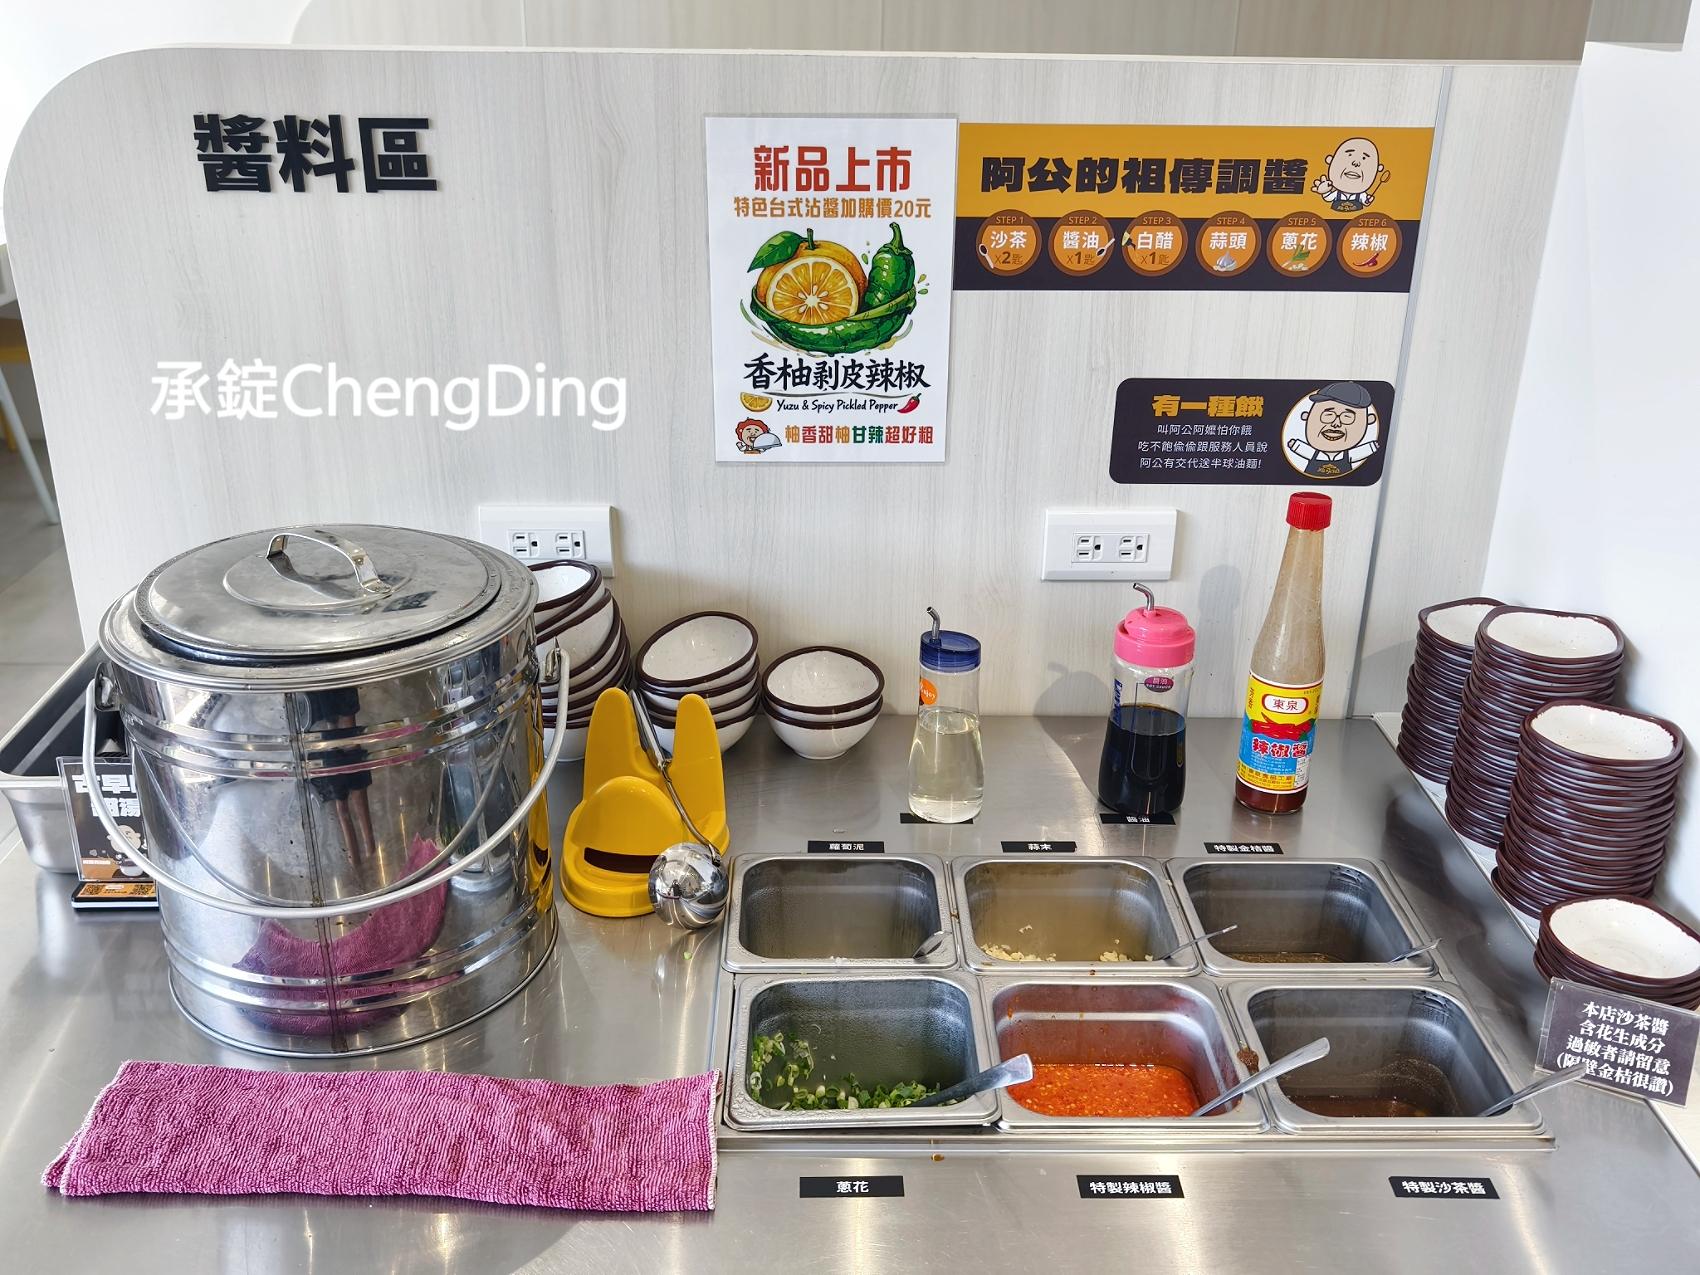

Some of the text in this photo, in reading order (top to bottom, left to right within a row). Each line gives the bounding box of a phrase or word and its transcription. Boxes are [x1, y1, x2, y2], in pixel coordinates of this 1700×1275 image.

[193, 113, 438, 193] 醬料區
[753, 145, 912, 192] 新品上市
[981, 157, 1308, 195] 阿公的祖傳調醬
[733, 197, 932, 218] 特色台式沾醬加購價20元
[995, 216, 1024, 224] STEP 1
[1068, 216, 1098, 224] STEP 2
[1142, 217, 1172, 225] STEP 3
[1216, 217, 1238, 225] STEP
[1287, 218, 1317, 226] STEP 5
[1358, 218, 1387, 227] STEP 6
[990, 230, 1027, 249] 沙茶
[1063, 231, 1100, 249] 醬油
[1137, 231, 1174, 250] 白醋
[1209, 232, 1247, 250] 蒜頭
[1351, 233, 1389, 251] 辣椒
[777, 398, 898, 413] Yuzu & Spicy Pickled Pepper
[1152, 394, 1264, 418] 有一種餓
[1273, 698, 1298, 711] 東泉
[1252, 737, 1308, 758] 辣椒醬
[1582, 1001, 1669, 1036] 本店沙茶醬
[1579, 1019, 1666, 1054] 含花生成分
[1566, 1035, 1671, 1076] 過敏者請留意
[1089, 1180, 1173, 1194] 特製辣椒醬
[1401, 1180, 1487, 1195] 特製沙茶醬
